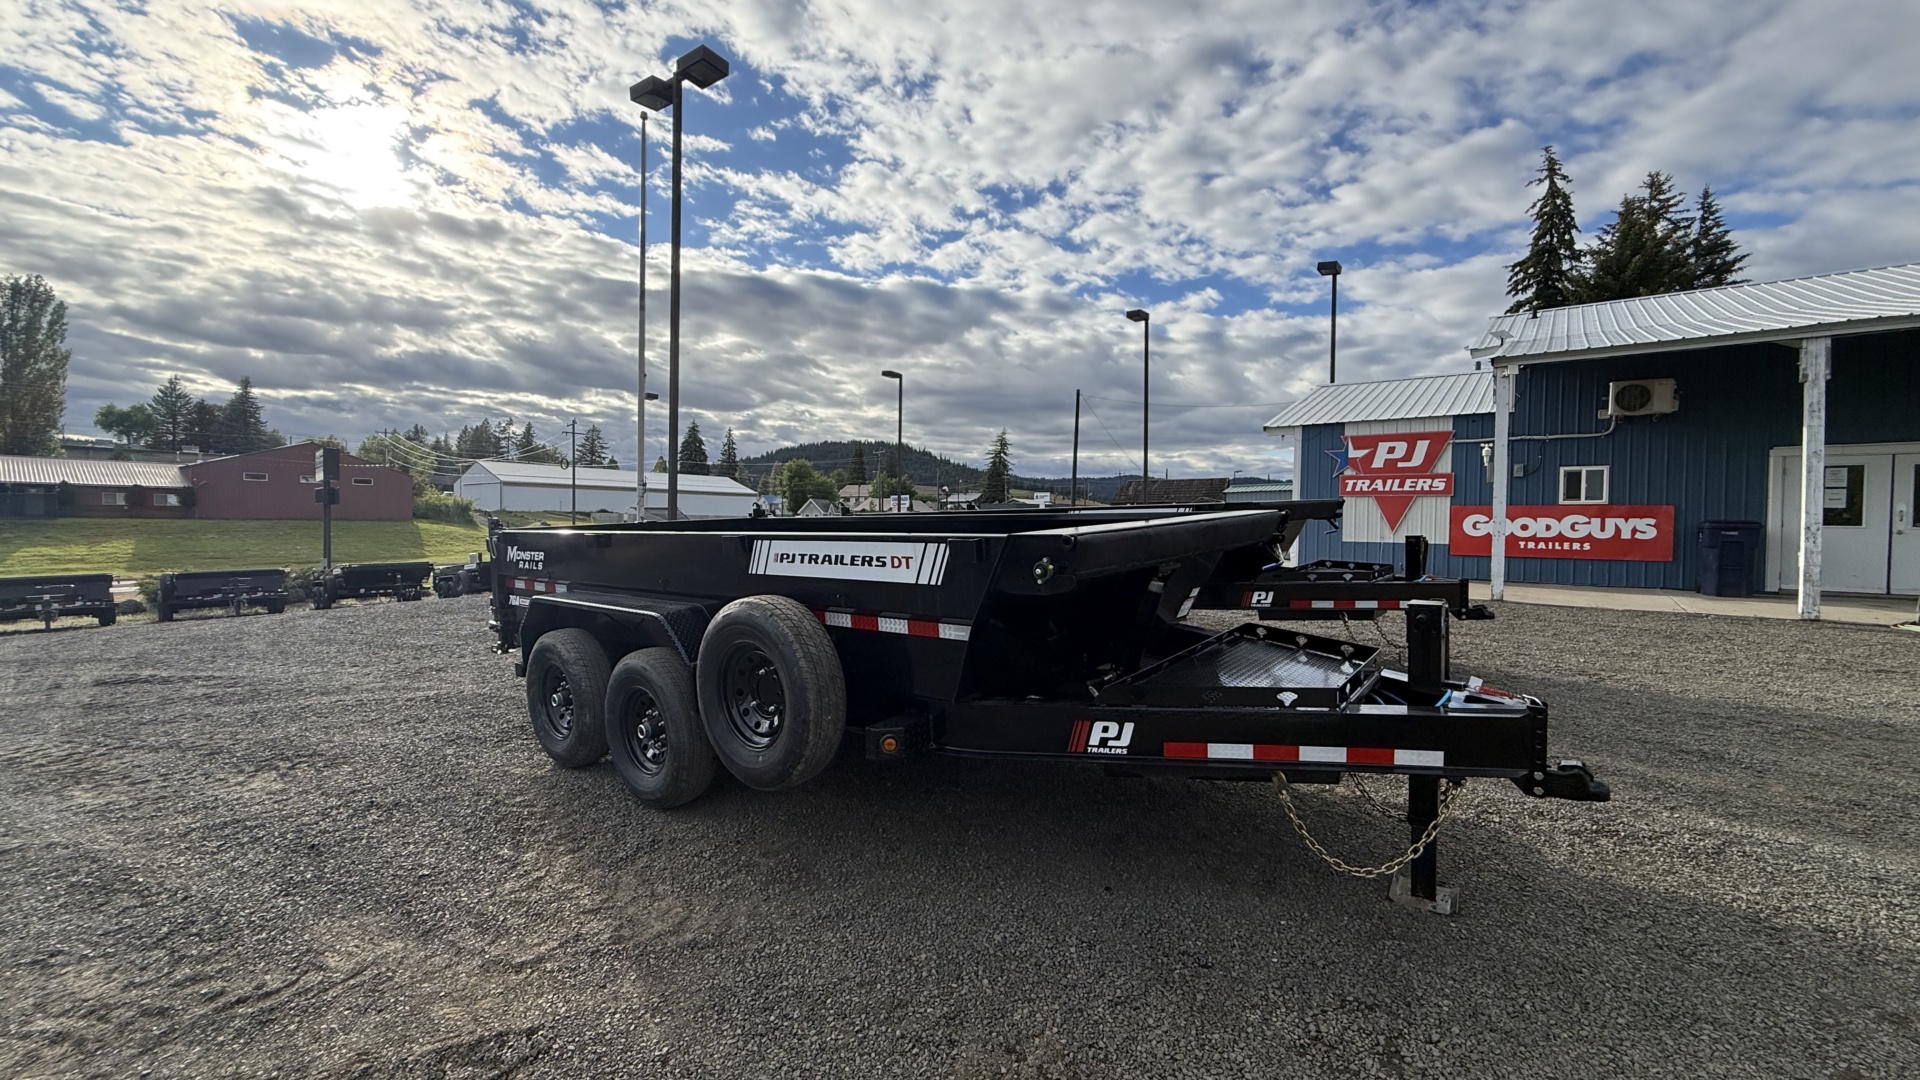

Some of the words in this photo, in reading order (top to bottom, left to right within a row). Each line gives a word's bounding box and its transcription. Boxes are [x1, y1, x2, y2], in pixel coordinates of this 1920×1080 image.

[1371, 440, 1431, 468] PJ
[1345, 478, 1447, 492] TRAILERS
[1518, 541, 1591, 551] TRAILERS
[507, 545, 545, 562] MONSTER
[519, 561, 543, 570] RAILS
[798, 553, 887, 568] TRAILERS
[890, 555, 914, 570] DT
[1251, 591, 1275, 604] PJ
[1088, 721, 1135, 747] PJ
[1087, 747, 1128, 755] TRAILERS
